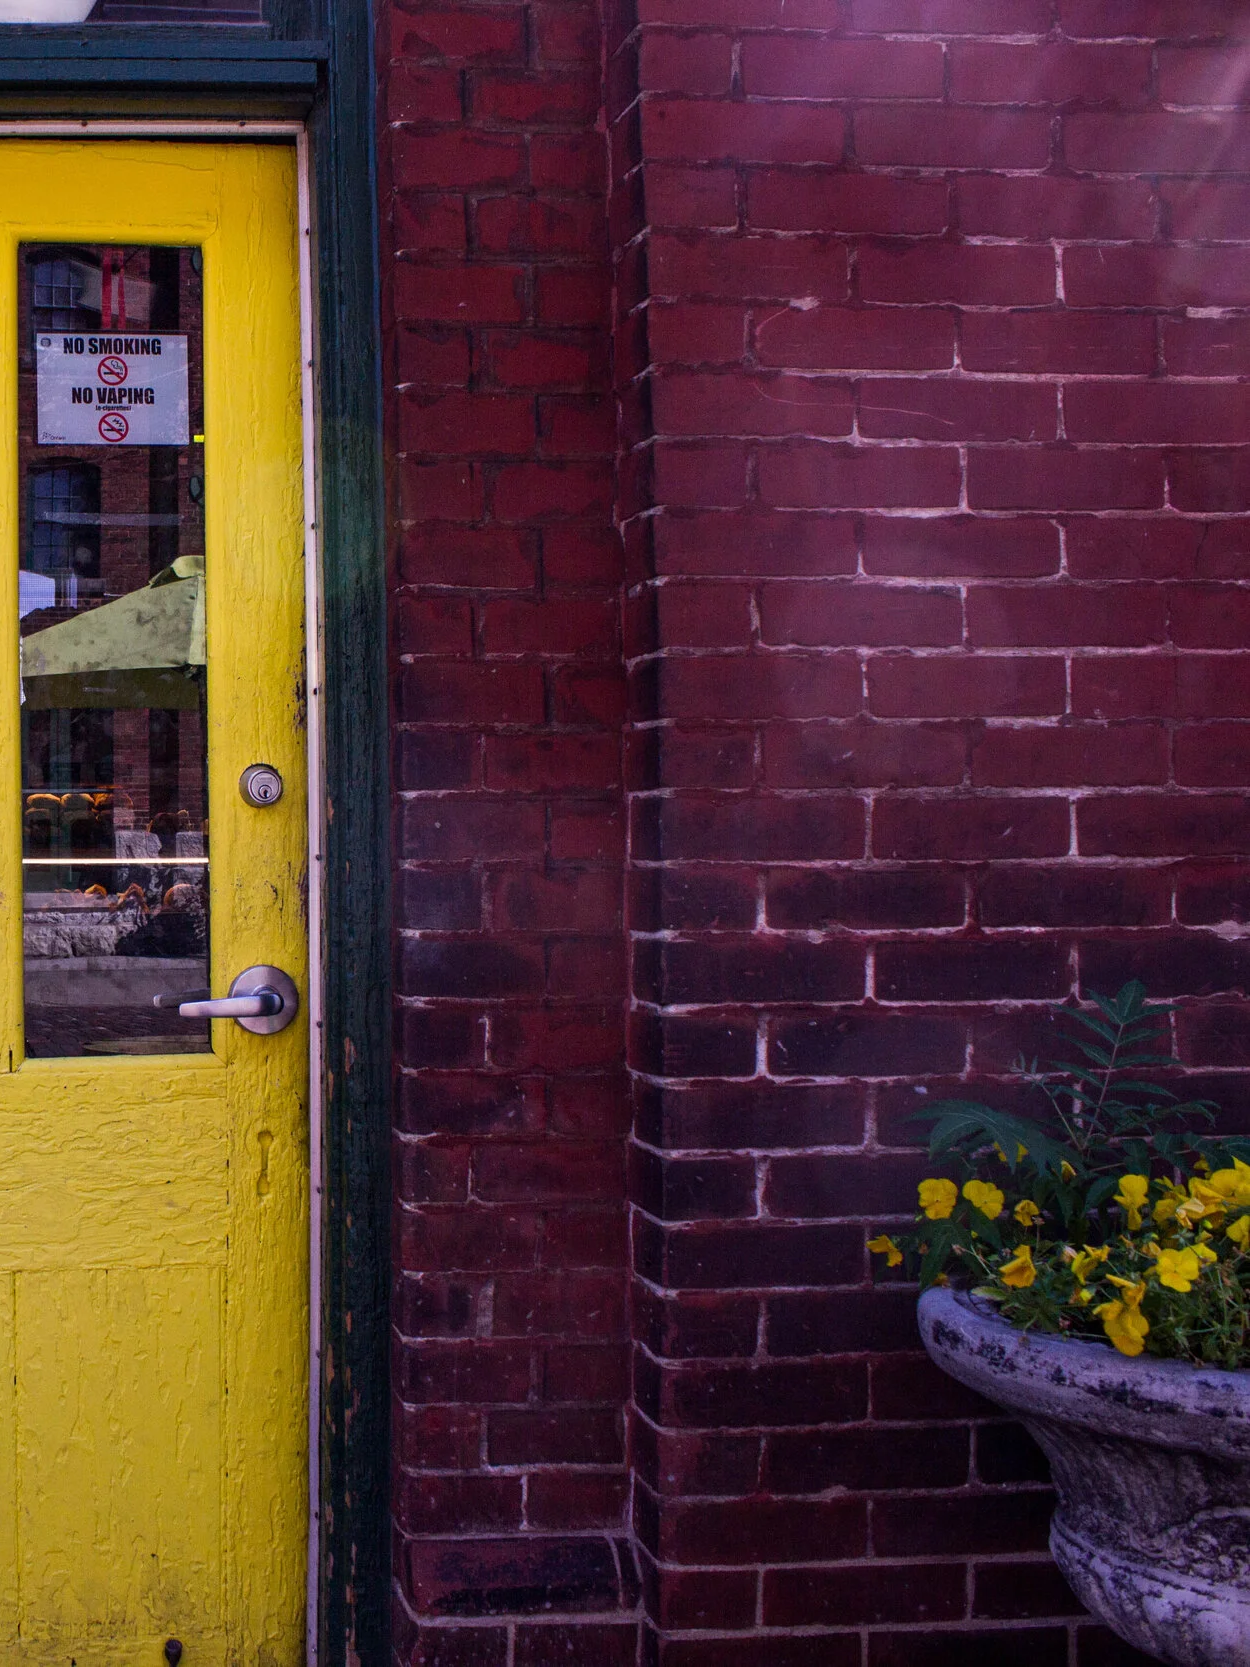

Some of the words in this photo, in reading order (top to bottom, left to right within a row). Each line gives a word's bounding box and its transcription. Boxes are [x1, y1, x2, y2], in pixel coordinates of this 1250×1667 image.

[63, 337, 84, 355] NO
[88, 337, 161, 355] SMOKING
[71, 387, 93, 404] NO
[95, 387, 155, 405] VAPING
